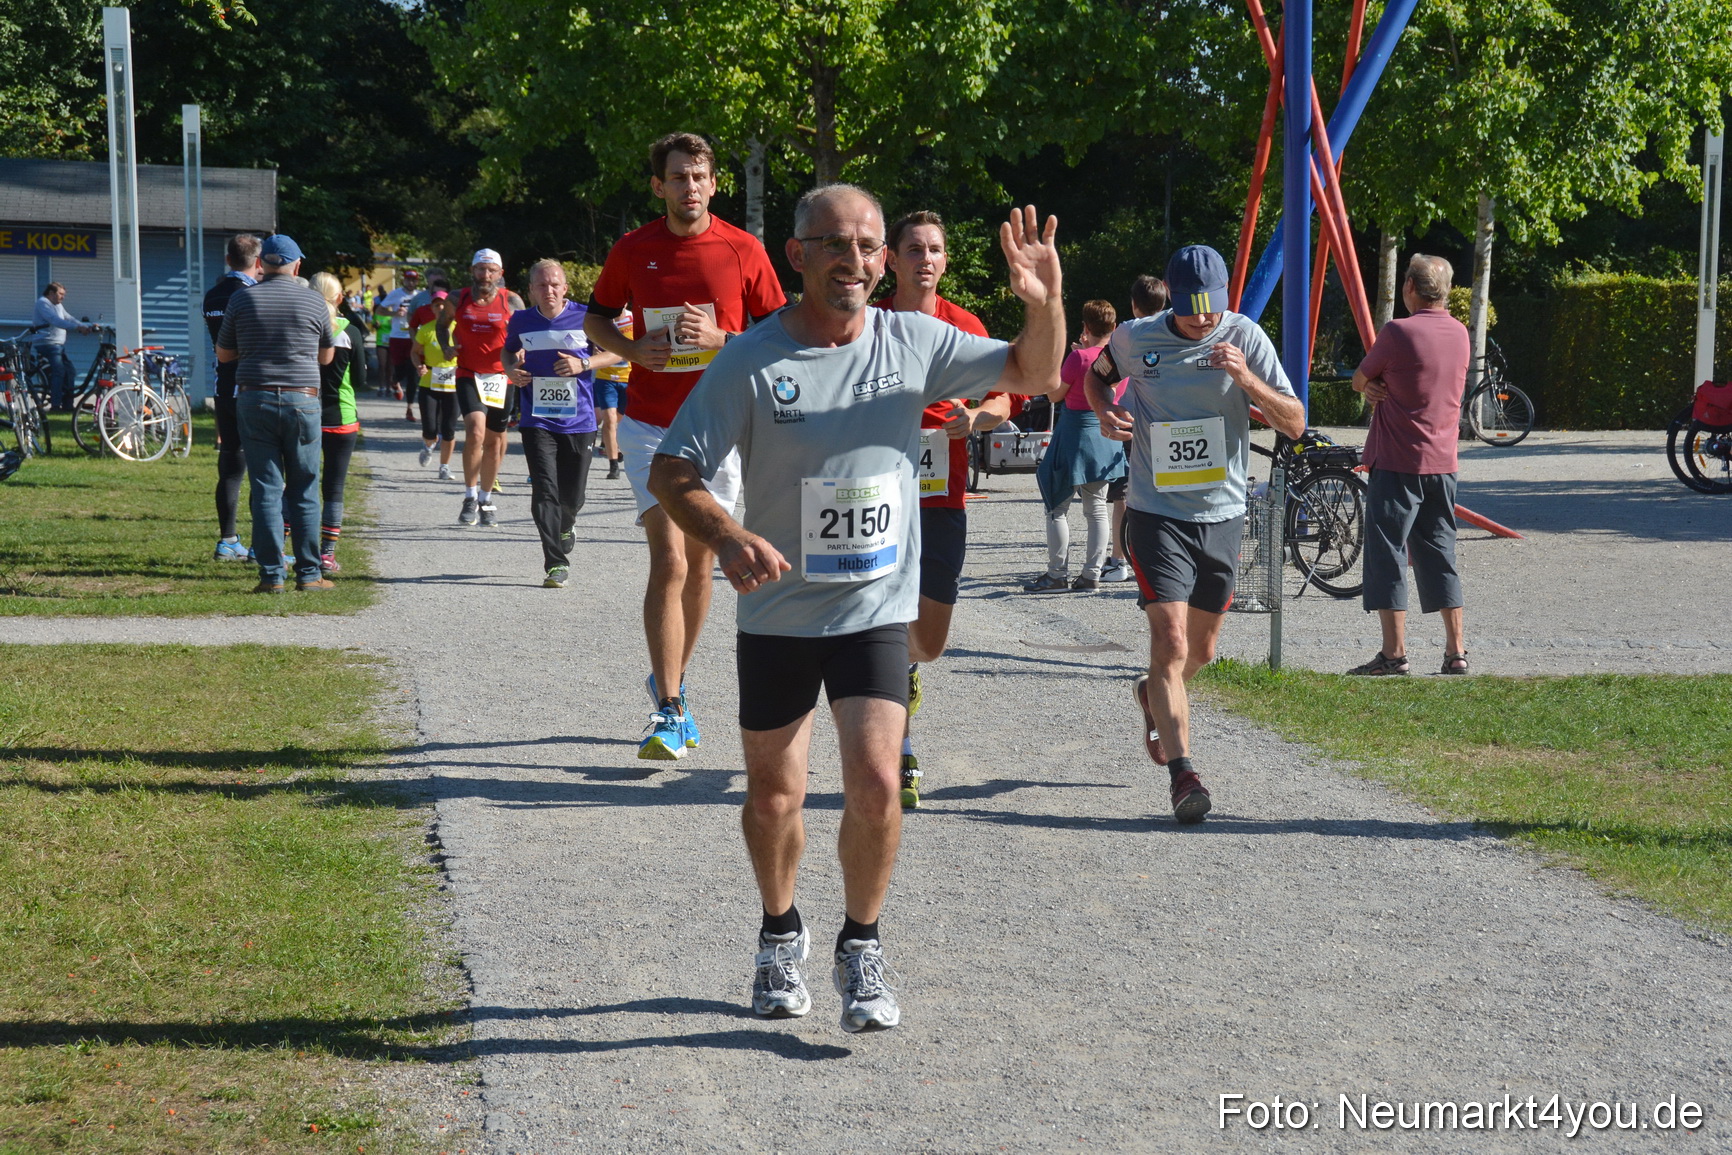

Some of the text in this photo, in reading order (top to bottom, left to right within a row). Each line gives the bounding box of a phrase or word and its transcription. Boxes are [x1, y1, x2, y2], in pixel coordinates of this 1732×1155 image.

[27, 232, 91, 252] KIOSK
[671, 356, 700, 366] Philipp
[483, 382, 500, 392] 222
[853, 372, 904, 396] BOCK
[540, 389, 571, 401] 2362
[773, 409, 805, 419] PARTL
[774, 417, 806, 425] Neumarkt
[1171, 425, 1204, 436] BOCK
[1169, 438, 1210, 462] 352
[836, 485, 881, 500] BOCK
[820, 503, 891, 539] 2150
[827, 540, 880, 551] PARTL Neumarkt
[838, 554, 878, 571] Hubert
